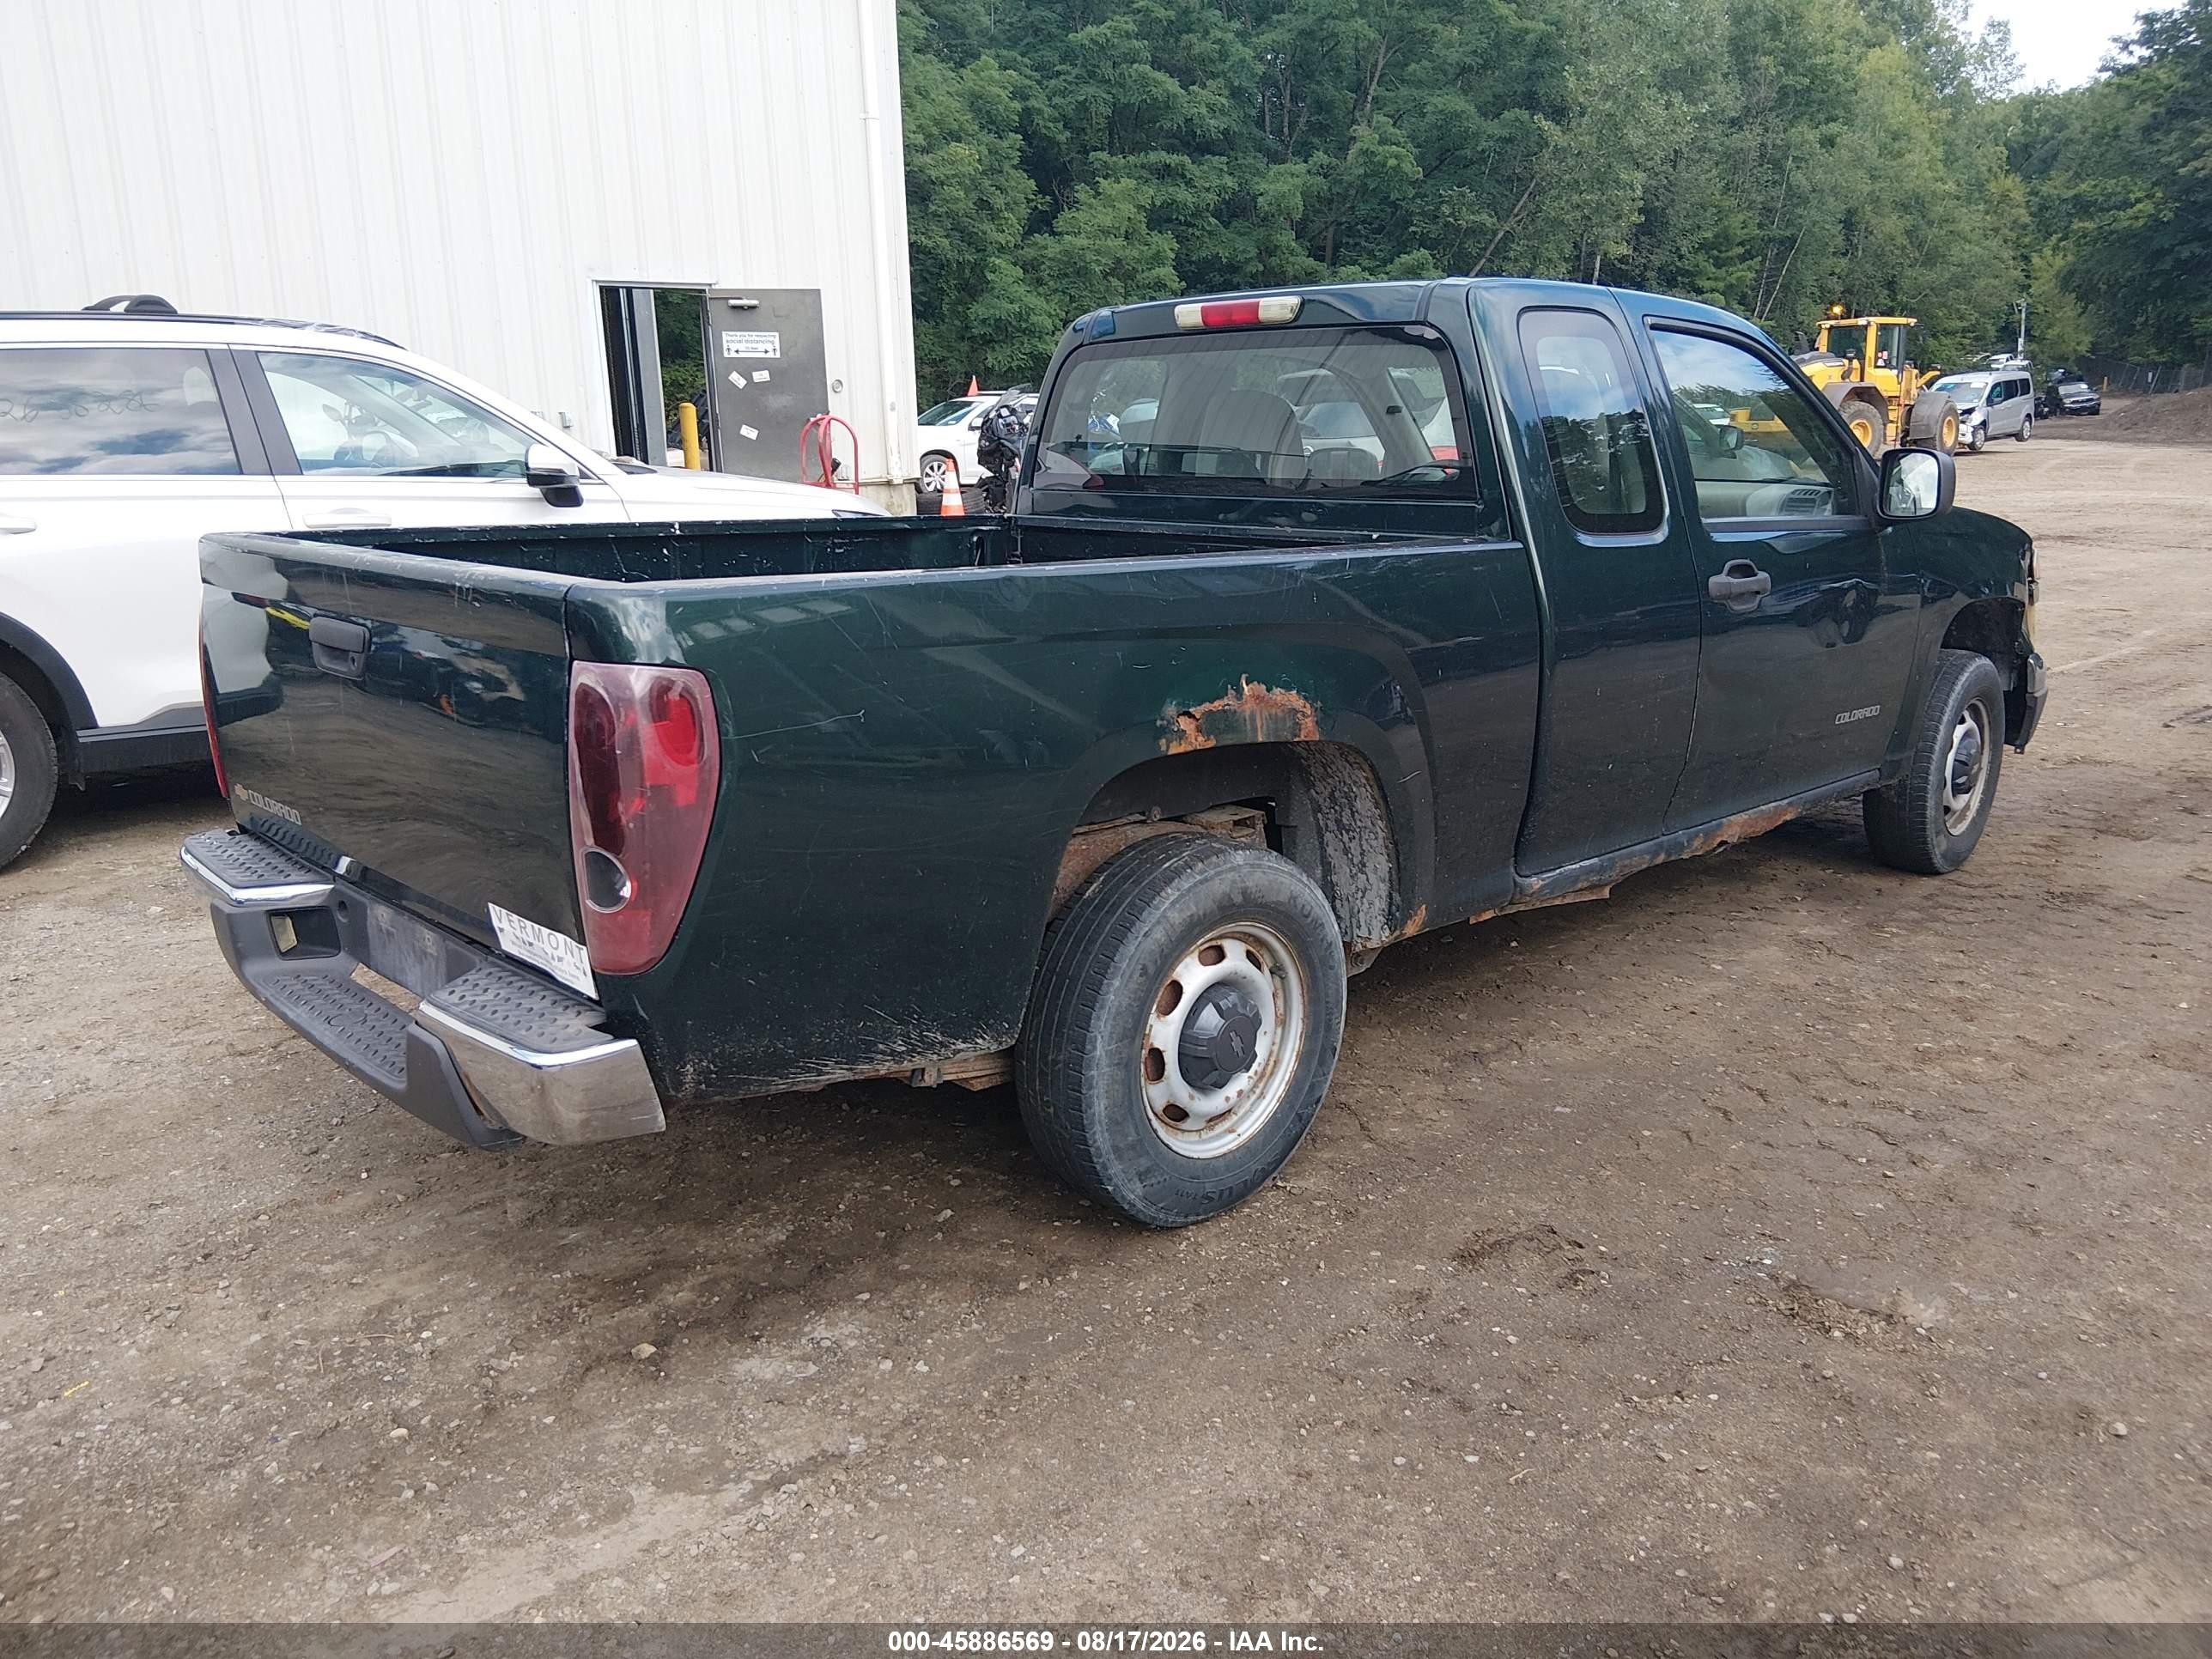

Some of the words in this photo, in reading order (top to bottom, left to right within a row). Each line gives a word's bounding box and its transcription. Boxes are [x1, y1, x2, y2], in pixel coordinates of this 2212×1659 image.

[1835, 705, 1881, 724] COLORADO
[248, 790, 301, 825] COLORADO
[493, 906, 585, 963] VERMONT
